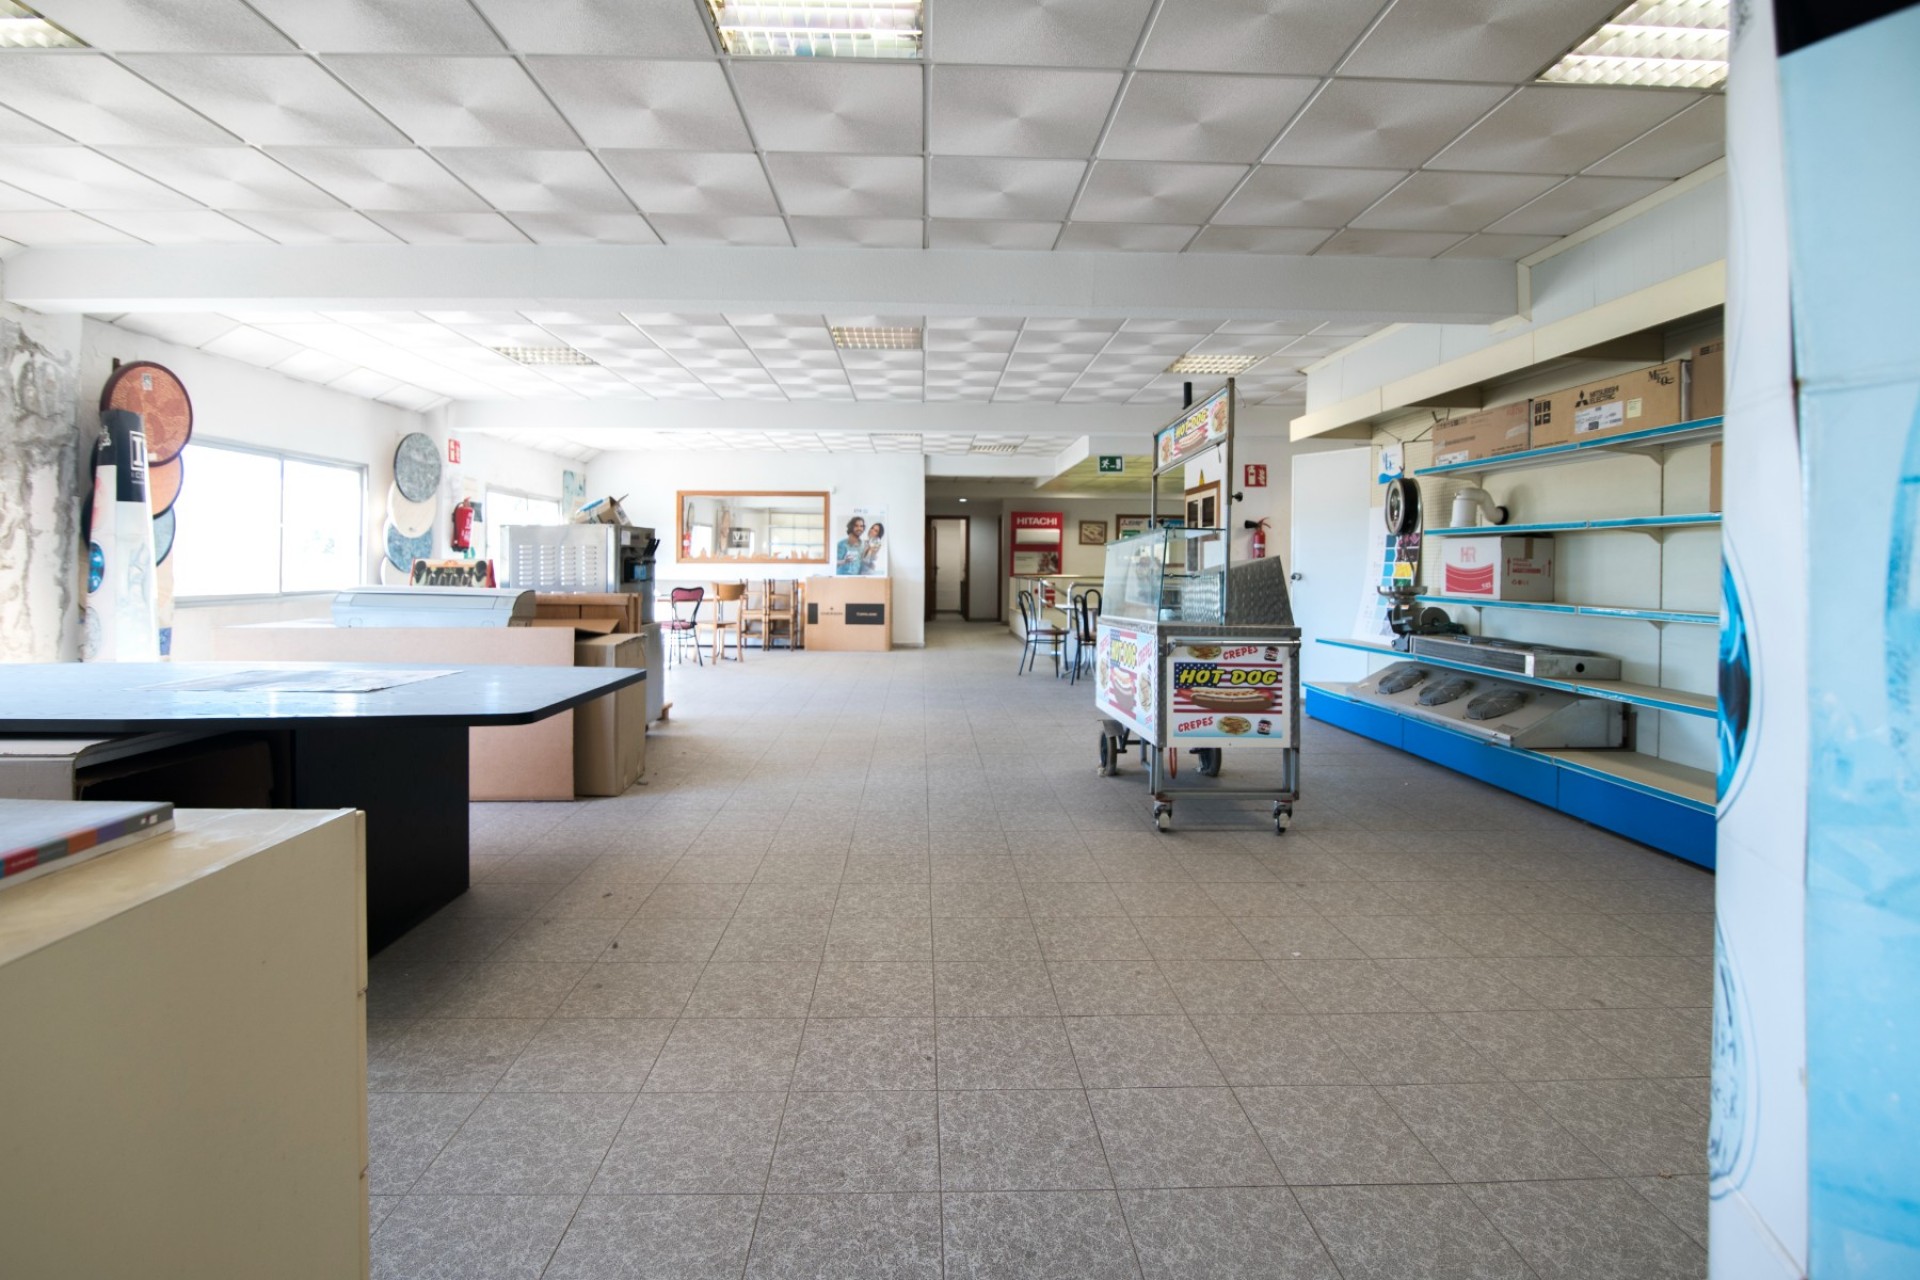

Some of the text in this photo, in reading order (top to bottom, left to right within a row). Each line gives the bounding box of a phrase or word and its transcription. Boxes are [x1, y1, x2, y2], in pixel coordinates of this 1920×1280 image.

[1016, 517, 1058, 526] HITACHI
[1223, 645, 1258, 660] CREPES
[1179, 669, 1278, 686] HOT DOG
[1178, 716, 1214, 733] CREPES
